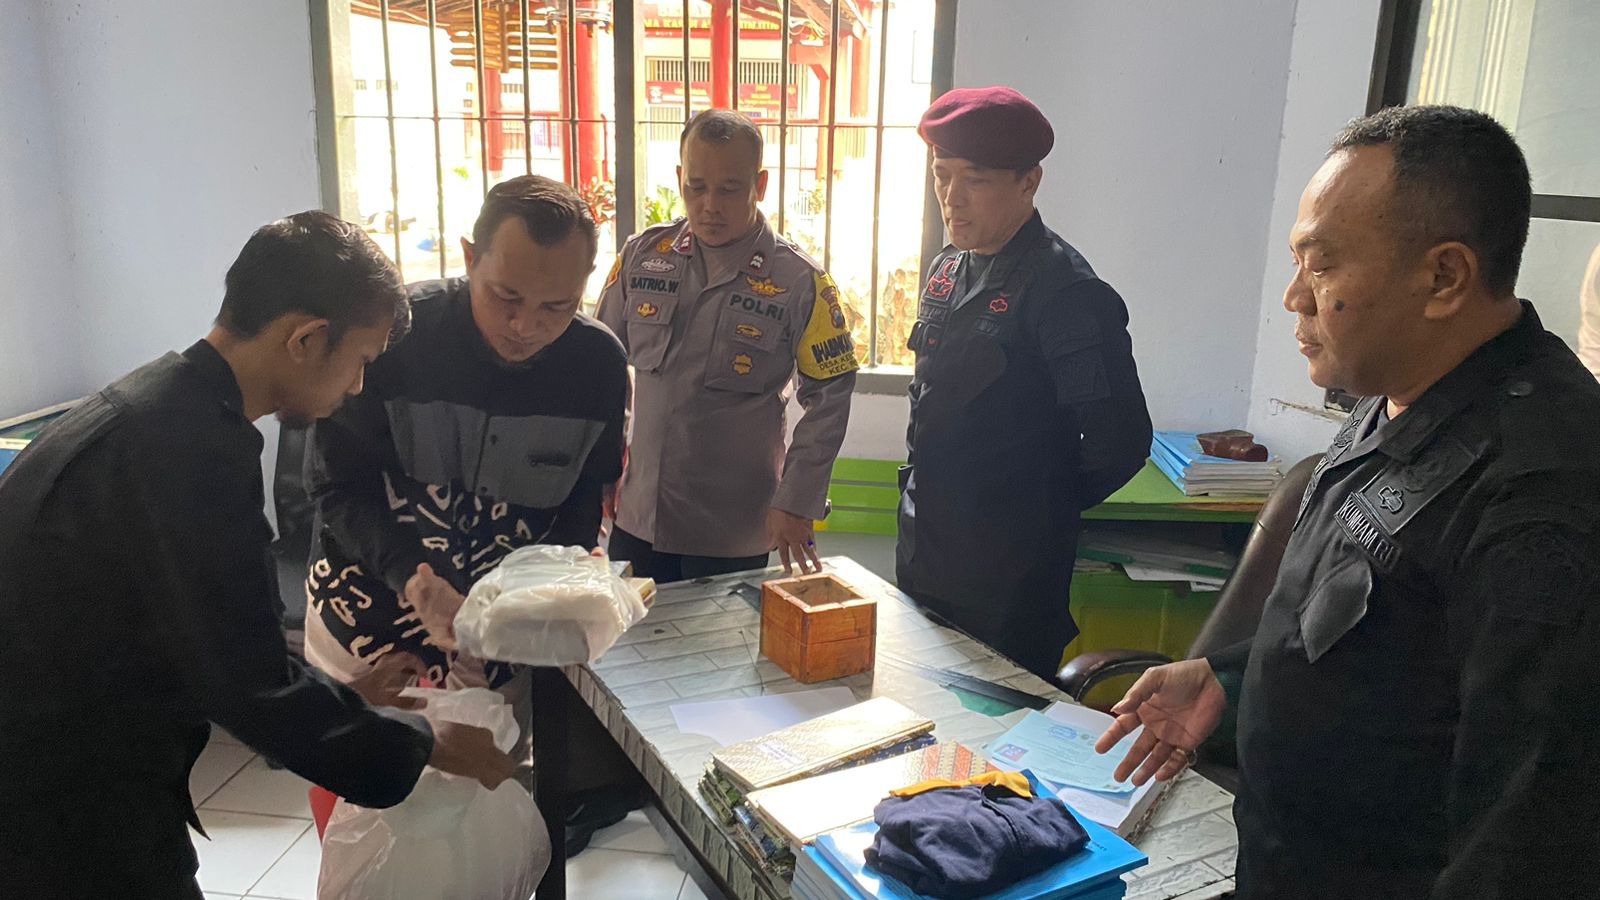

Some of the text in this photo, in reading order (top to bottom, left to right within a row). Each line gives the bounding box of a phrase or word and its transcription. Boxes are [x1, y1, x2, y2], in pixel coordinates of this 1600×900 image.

[630, 276, 679, 293] SATRIO.W
[729, 294, 785, 321] POLRI
[1339, 499, 1394, 564] KUMHAM RI
